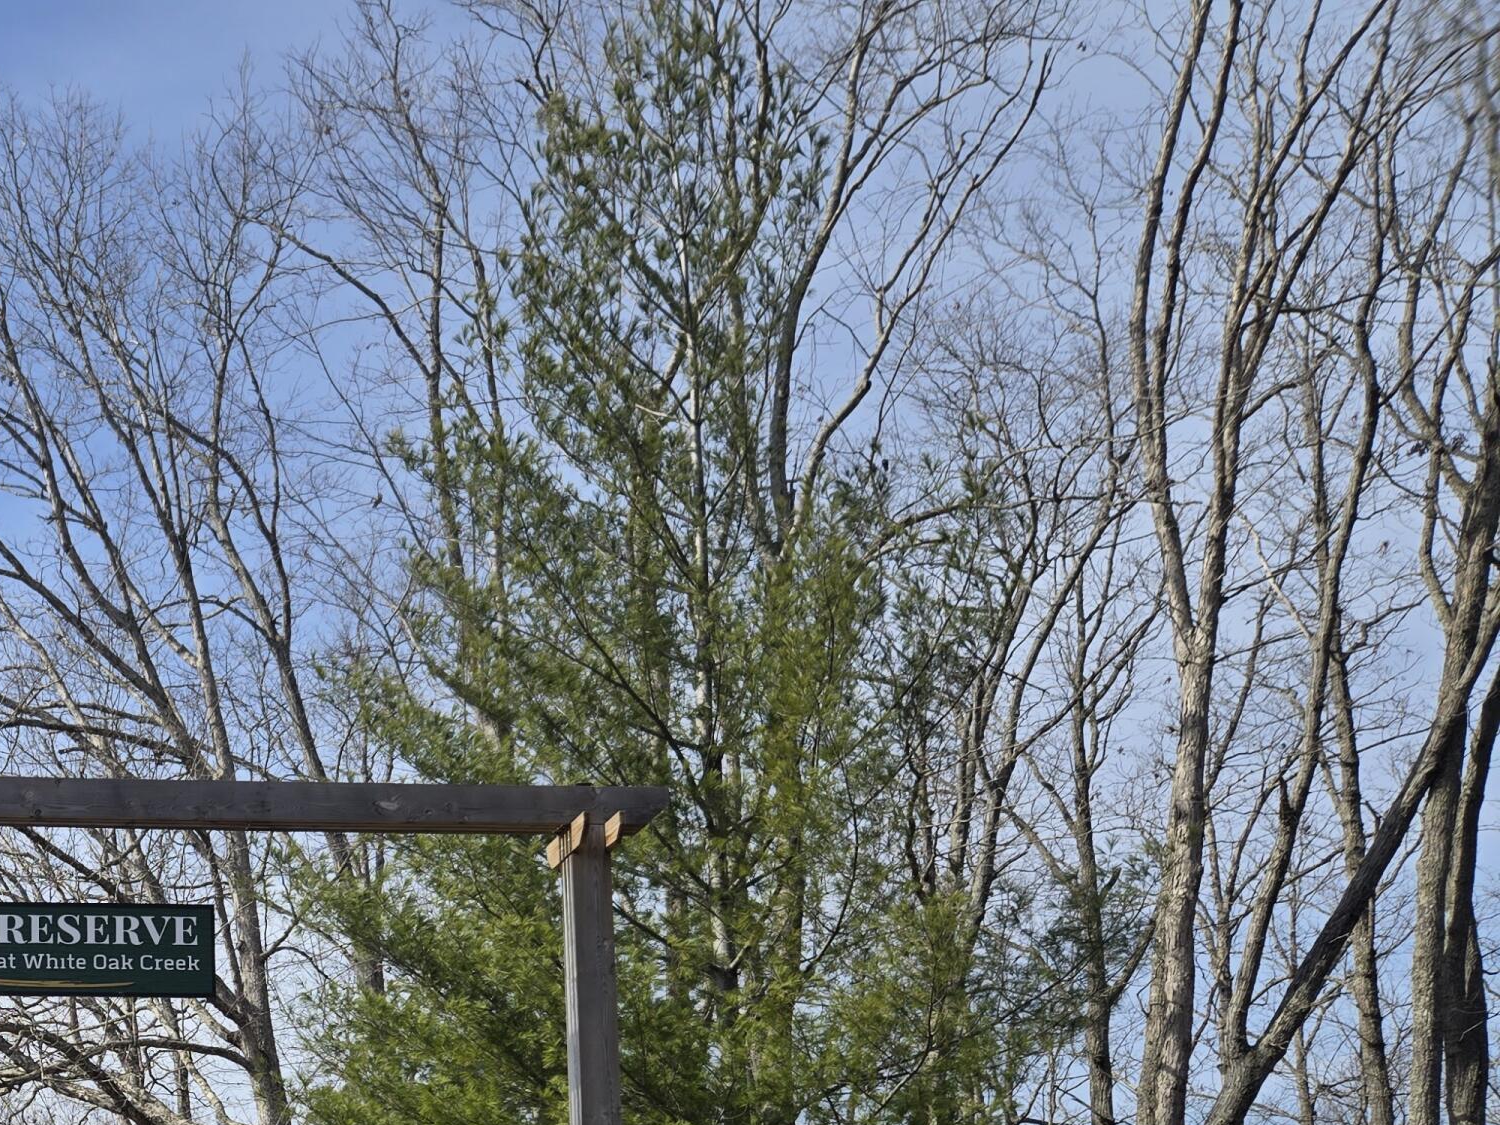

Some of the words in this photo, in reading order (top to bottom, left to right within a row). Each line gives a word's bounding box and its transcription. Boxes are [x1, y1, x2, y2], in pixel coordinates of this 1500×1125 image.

[22, 953, 87, 971] White
[92, 953, 133, 971] Oak
[139, 954, 201, 972] Creek
